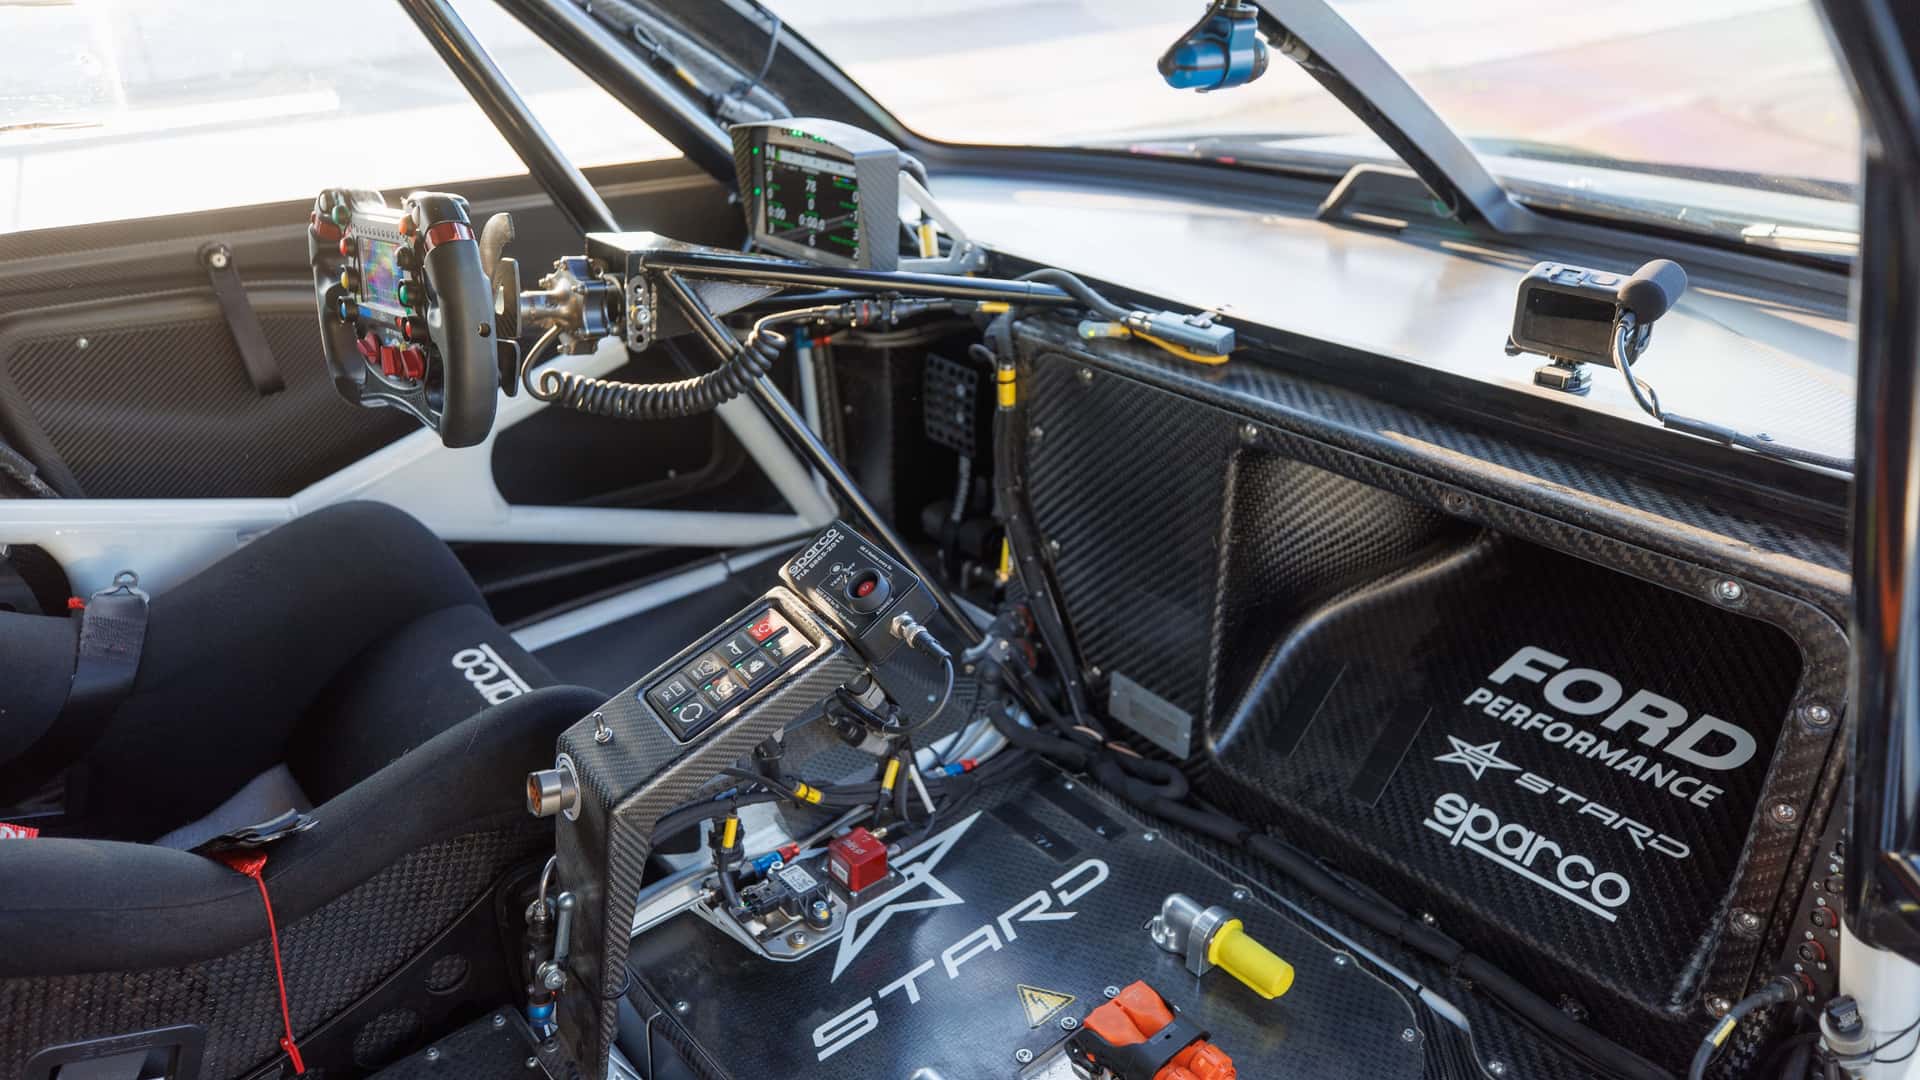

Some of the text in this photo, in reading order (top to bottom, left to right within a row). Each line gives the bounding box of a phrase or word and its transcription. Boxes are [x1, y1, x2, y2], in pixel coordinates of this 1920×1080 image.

[1463, 687, 1725, 808] PERFORMANCE
[1488, 646, 1756, 770] FORD
[1428, 793, 1631, 914] sparco
[1515, 772, 1691, 859] STARD
[813, 859, 1110, 1062] STARD
